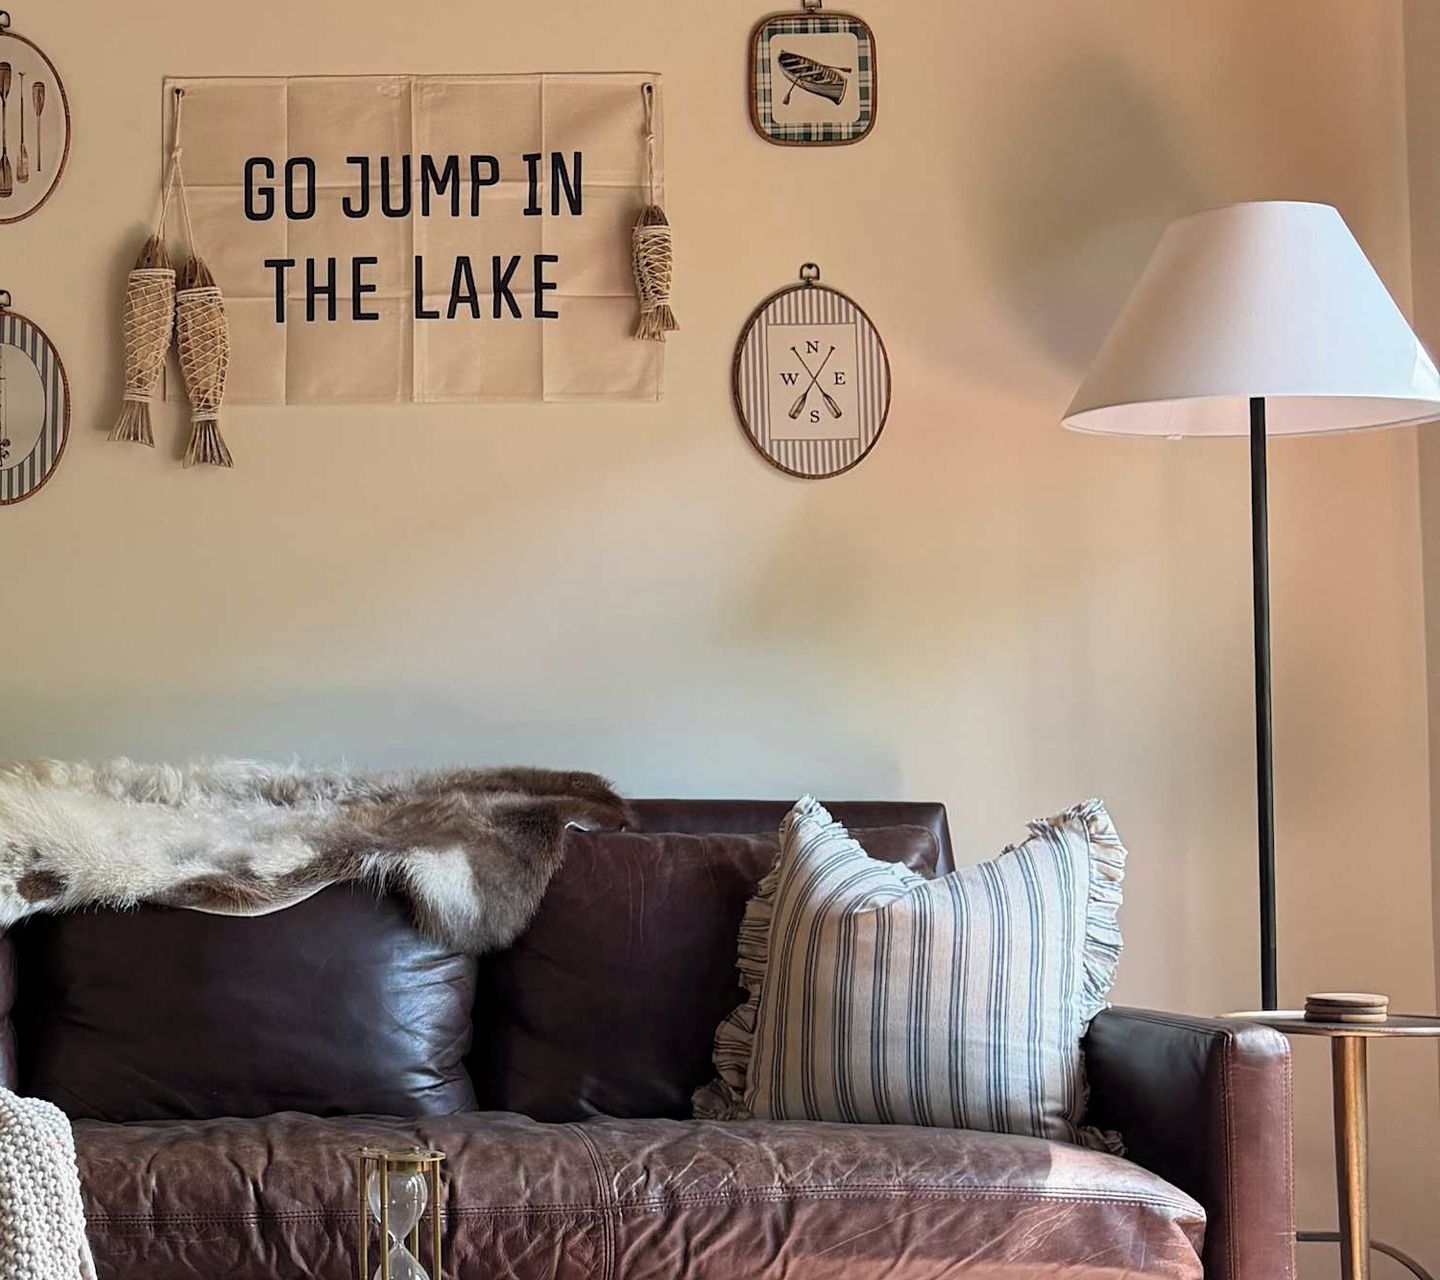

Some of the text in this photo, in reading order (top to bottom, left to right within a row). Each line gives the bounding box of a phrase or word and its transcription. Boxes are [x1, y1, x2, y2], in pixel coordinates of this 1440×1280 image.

[244, 151, 583, 221] GO JUMP IN
[264, 254, 559, 323] THE LAKE
[806, 340, 819, 354] N
[779, 371, 846, 386] W E
[809, 409, 820, 424] S
